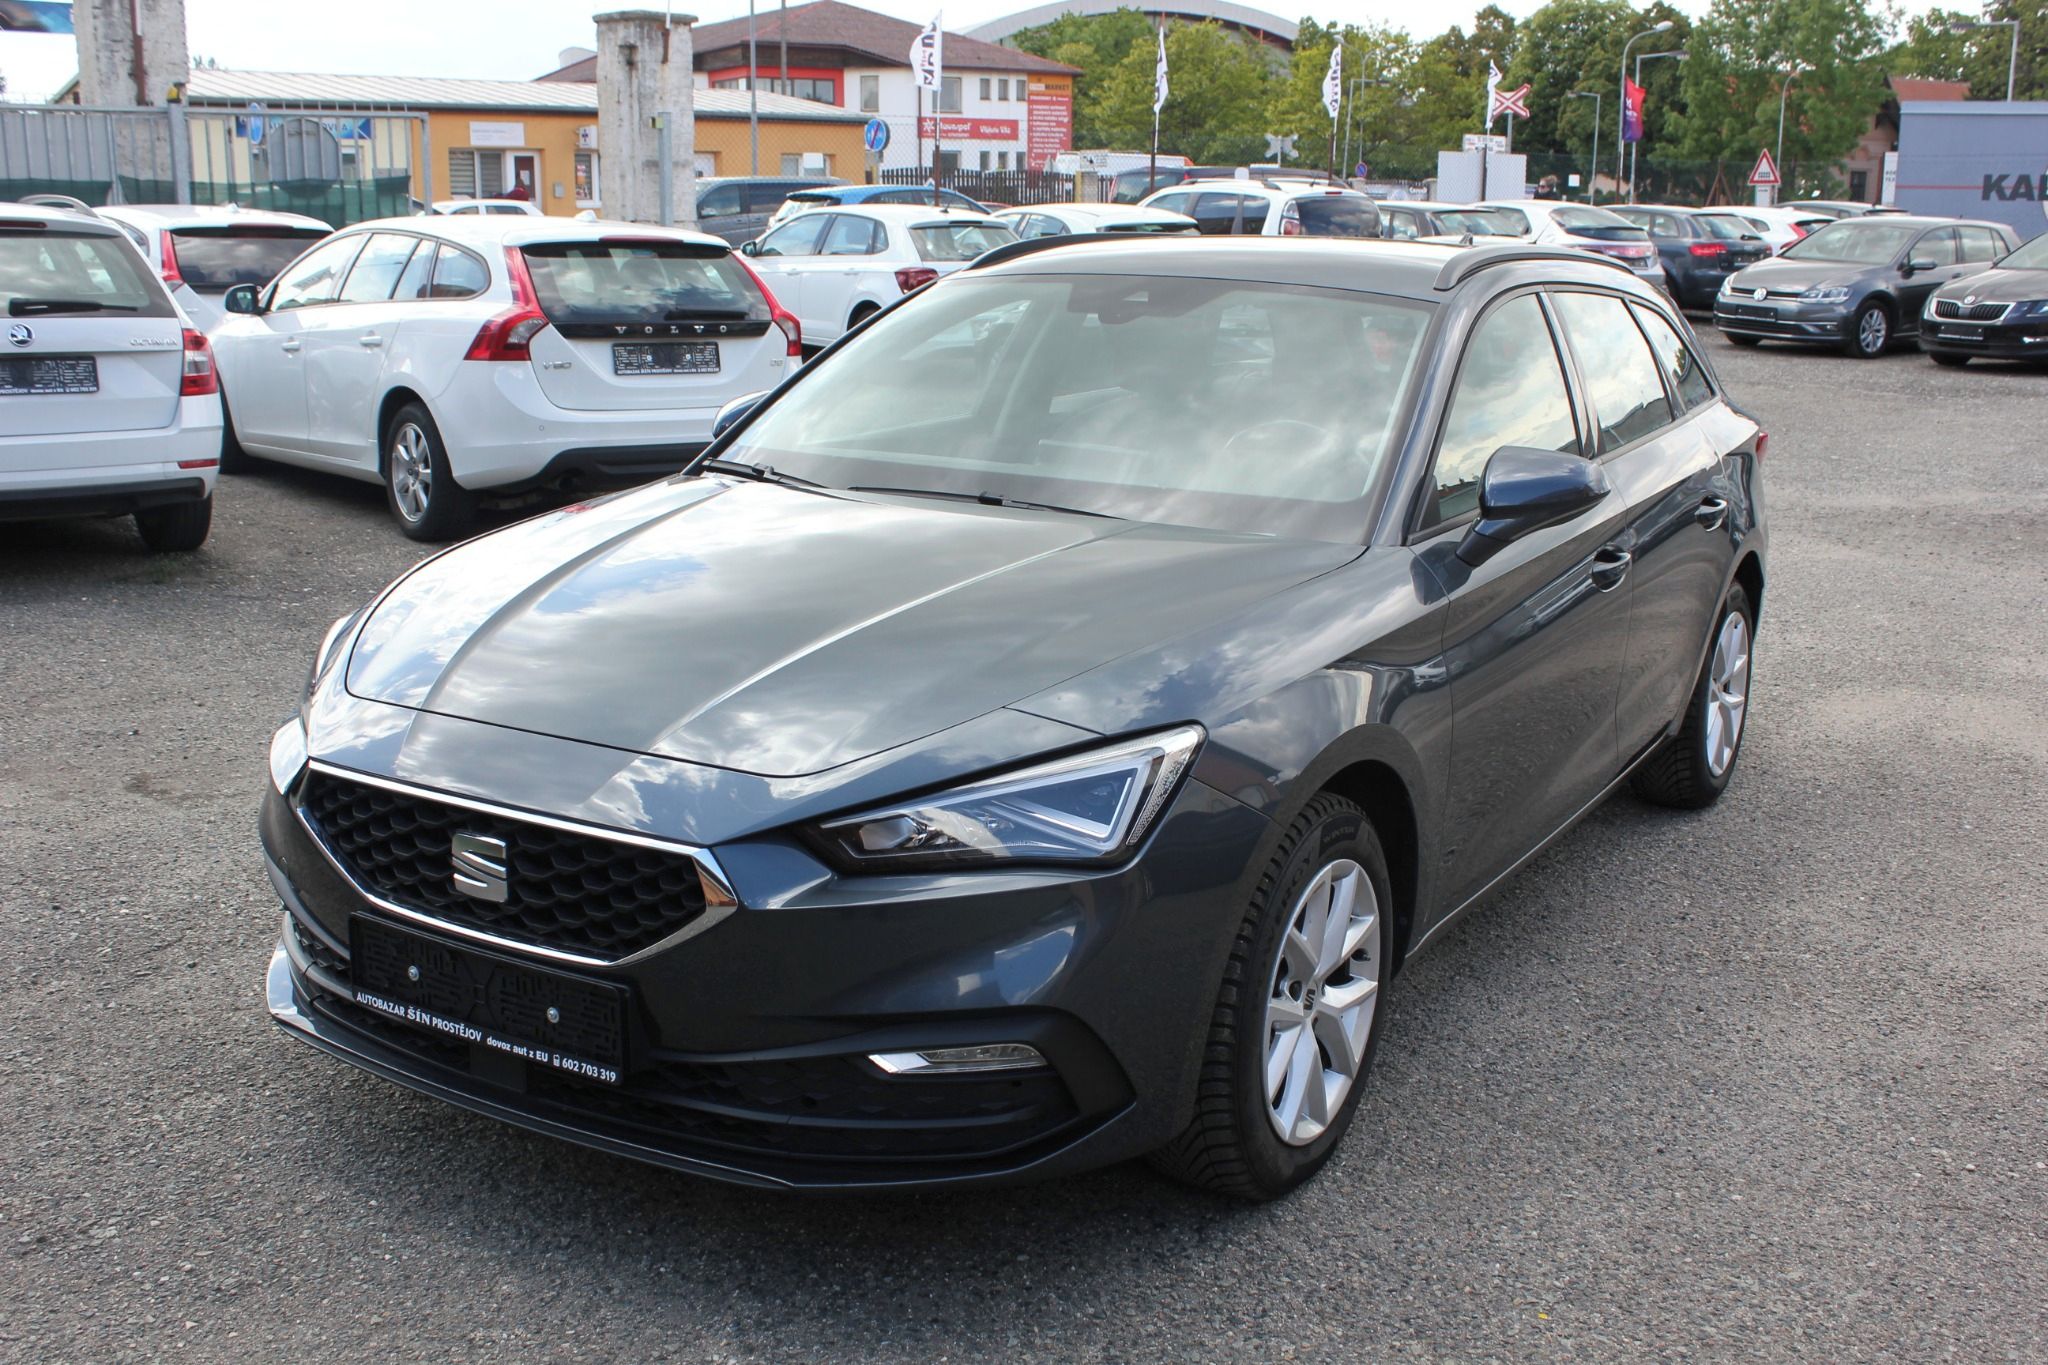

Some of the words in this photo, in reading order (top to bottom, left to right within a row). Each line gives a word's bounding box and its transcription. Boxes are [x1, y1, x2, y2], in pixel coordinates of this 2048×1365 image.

[615, 325, 727, 335] VOLVO
[356, 991, 405, 1017] AUTOBAZAR
[407, 1005, 430, 1025] ŠÍN
[432, 1016, 482, 1042] PROSTĚJOV
[486, 1035, 511, 1051] dovoz
[513, 1044, 527, 1056] aut
[528, 1050, 535, 1058] z
[536, 1050, 549, 1062] EU
[562, 1057, 579, 1072] 602
[580, 1062, 598, 1077] 703
[599, 1068, 617, 1082] 319
